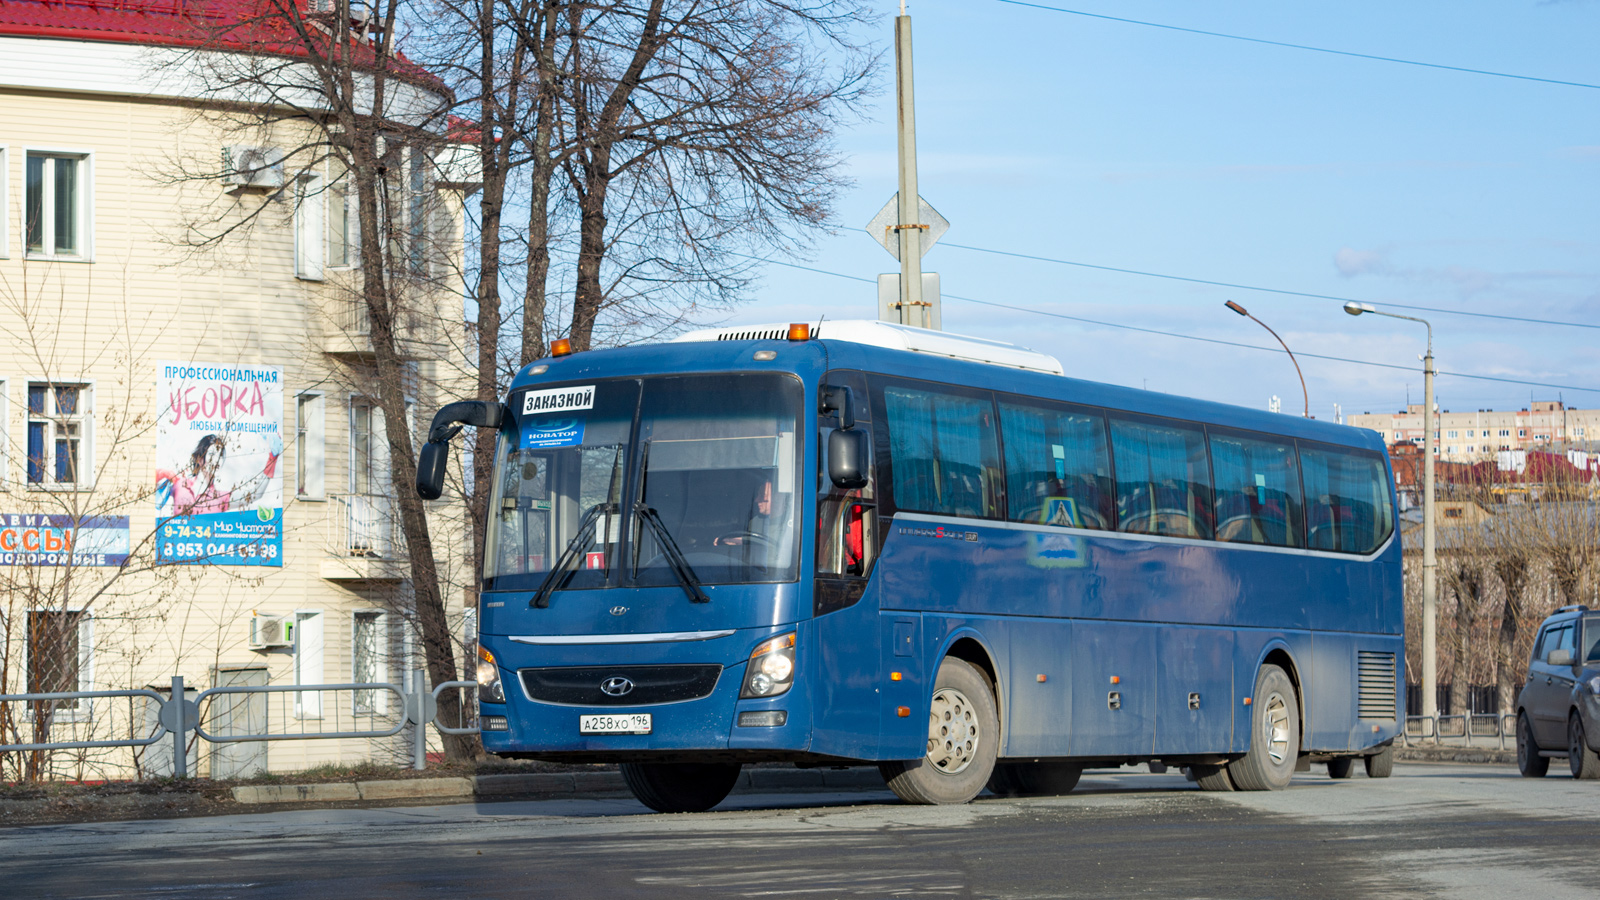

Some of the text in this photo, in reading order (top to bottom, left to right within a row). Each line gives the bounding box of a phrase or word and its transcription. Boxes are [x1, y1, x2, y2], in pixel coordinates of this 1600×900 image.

[165, 366, 278, 383] ПРОФЕССИОНАЛЬНАЯ
[169, 381, 264, 425] УБОРКА
[526, 389, 592, 411] ЗАКАЗНОЙ
[189, 421, 278, 433] ЛЮБЫХ ПОМЕЩЕНИЙ
[529, 431, 578, 439] НОВАТОР
[164, 526, 211, 538] 9-74-34
[214, 521, 276, 533] Мир Чистоты
[164, 543, 173, 556] 8
[176, 543, 203, 557] 953
[206, 543, 234, 557] 044
[631, 716, 648, 725] 196
